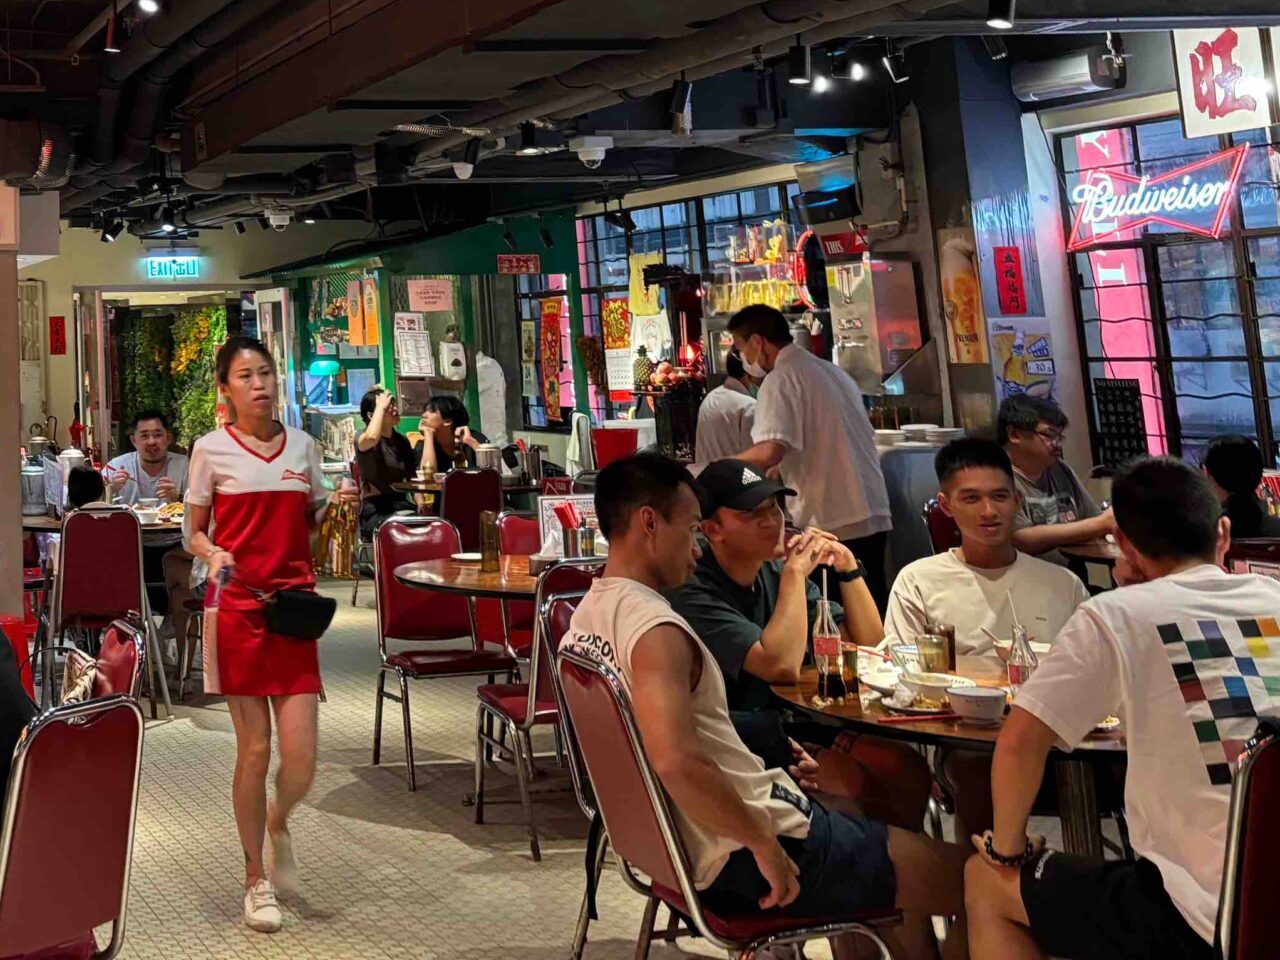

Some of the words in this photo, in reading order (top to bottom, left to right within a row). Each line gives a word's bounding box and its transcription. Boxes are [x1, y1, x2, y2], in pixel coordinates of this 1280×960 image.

[1190, 27, 1257, 120] 旺
[1072, 169, 1236, 224] Budweiser
[150, 260, 172, 276] EXIT
[176, 259, 196, 276] 出口
